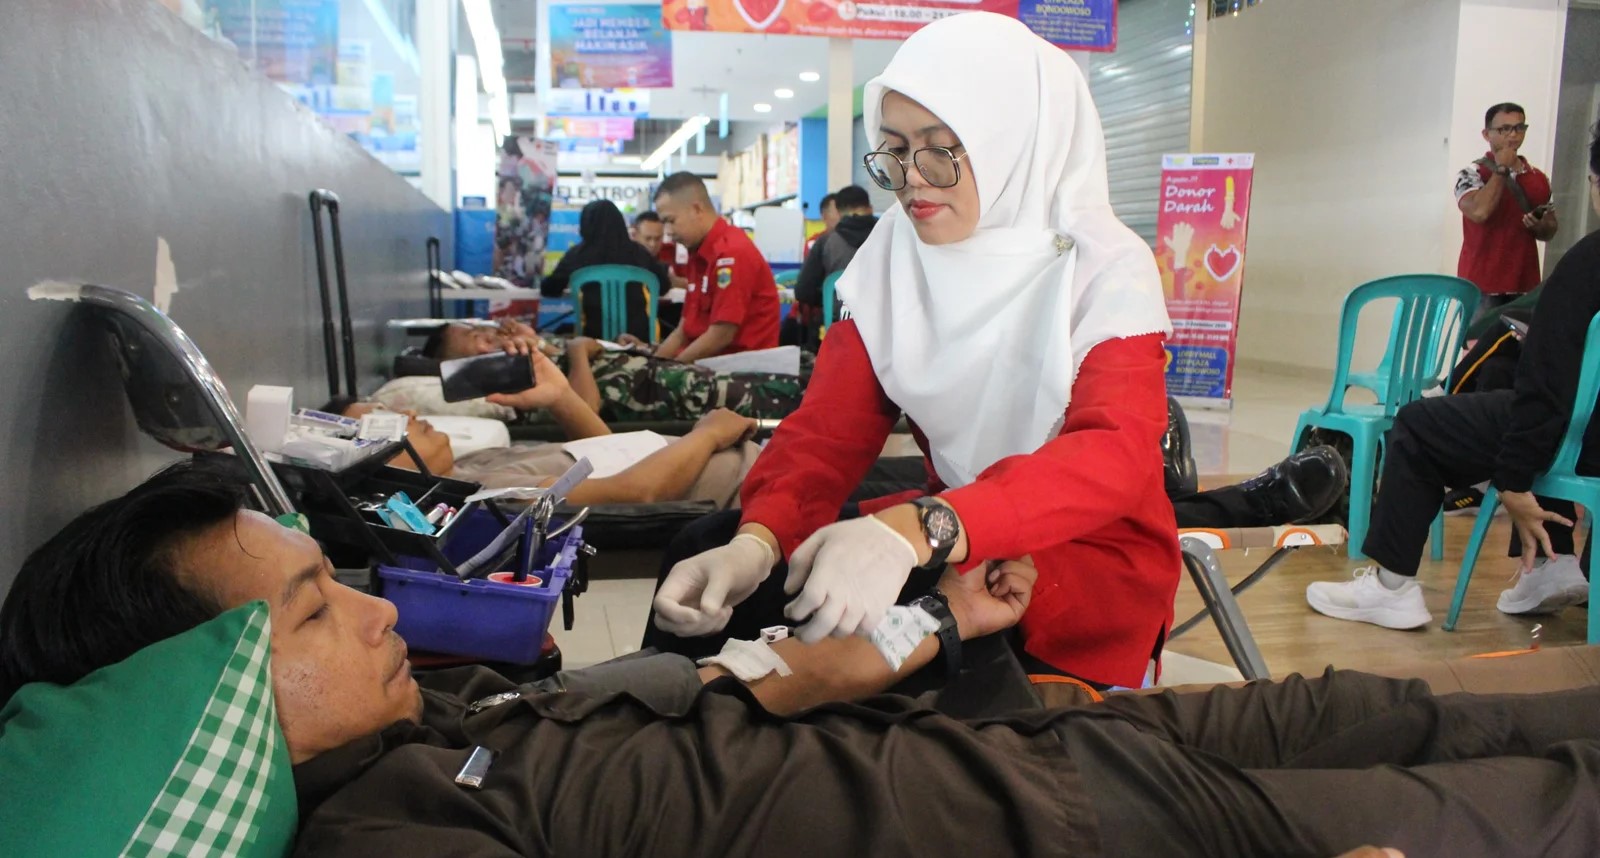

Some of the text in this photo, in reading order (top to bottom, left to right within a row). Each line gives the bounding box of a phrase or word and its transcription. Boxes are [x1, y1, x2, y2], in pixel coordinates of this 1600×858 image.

[857, 7, 885, 17] Pukul
[1035, 4, 1091, 16] BONDOWOSO
[574, 17, 651, 28] JADI MEMBER
[584, 28, 639, 39] BELANJA
[1165, 185, 1217, 198] Donor
[1164, 199, 1215, 213] Darah
